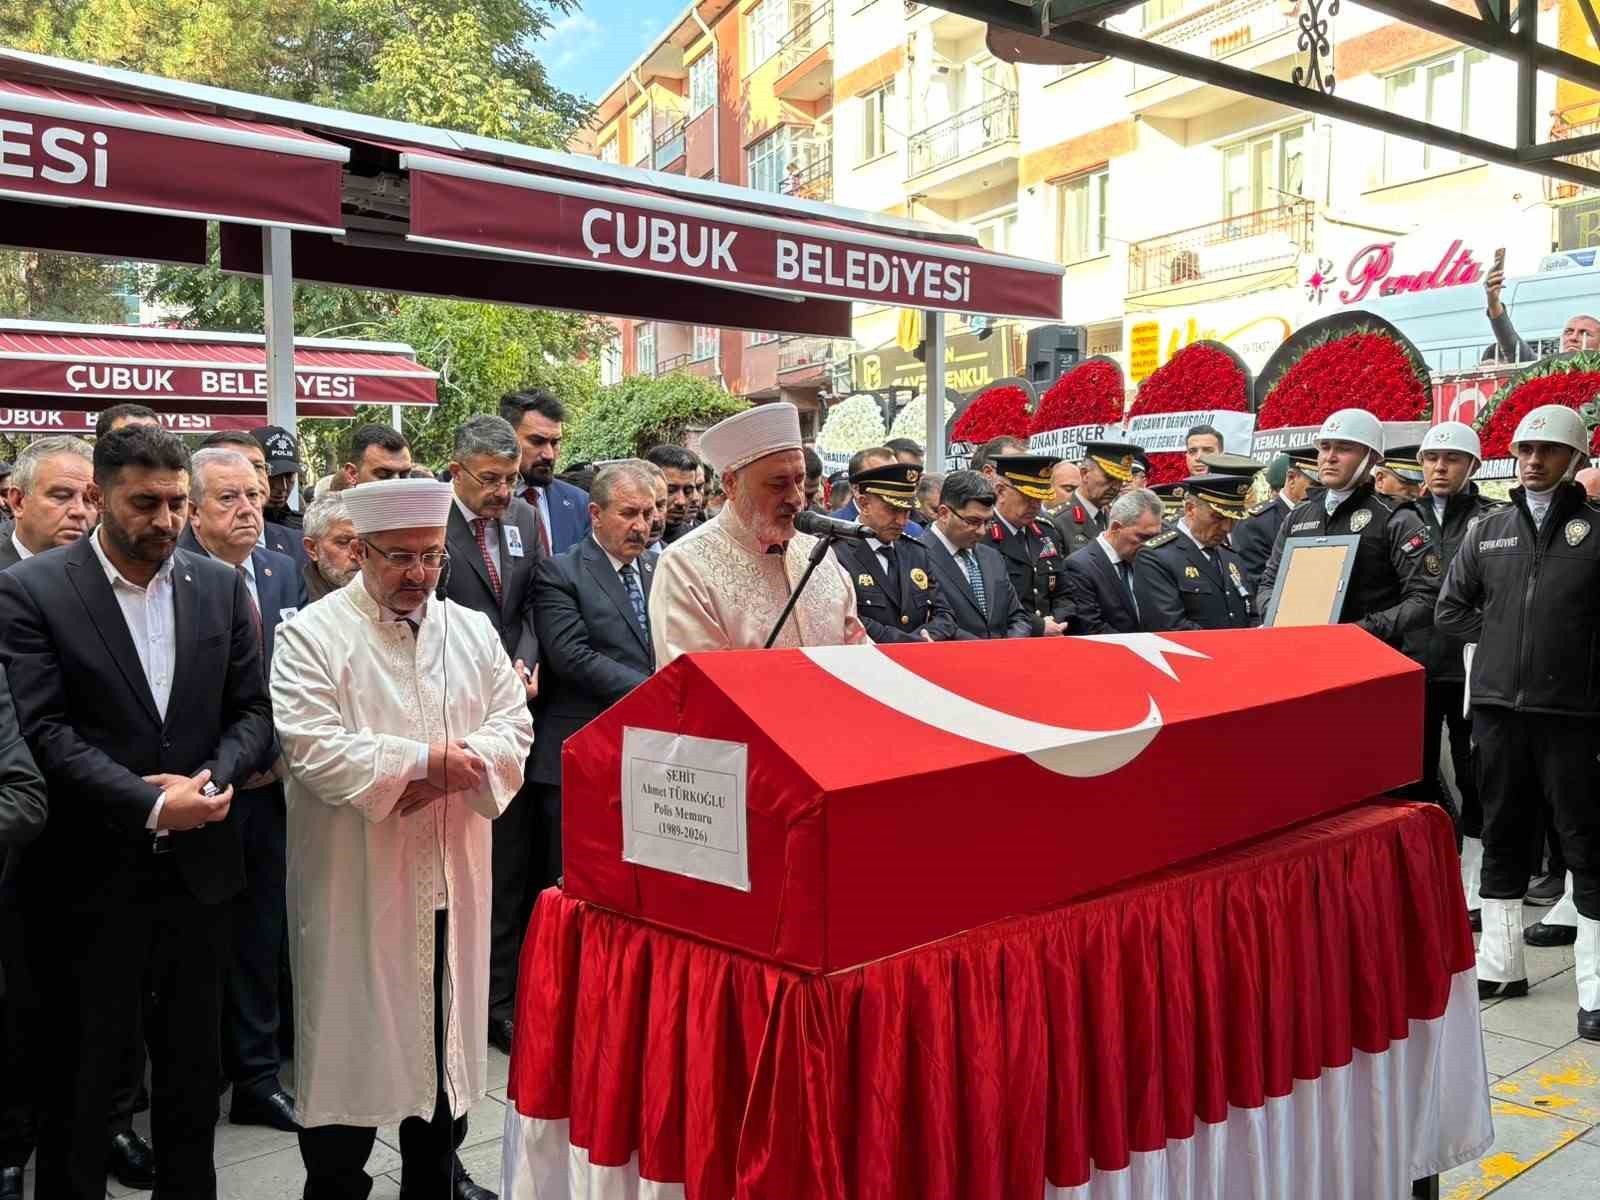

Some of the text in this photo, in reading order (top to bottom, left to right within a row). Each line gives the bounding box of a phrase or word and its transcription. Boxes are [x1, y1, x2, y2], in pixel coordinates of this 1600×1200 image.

[582, 207, 738, 272] ÇUBUK
[65, 365, 174, 392] ÇUBUK
[1062, 426, 1105, 445] BEKER
[1253, 434, 1287, 451] KEMAL
[666, 768, 696, 784] ŞEHİT
[641, 783, 726, 808] Ahmet TÜRKOĞLU
[654, 802, 712, 825] Polis Memuru
[658, 823, 708, 843] (1989-2026)
